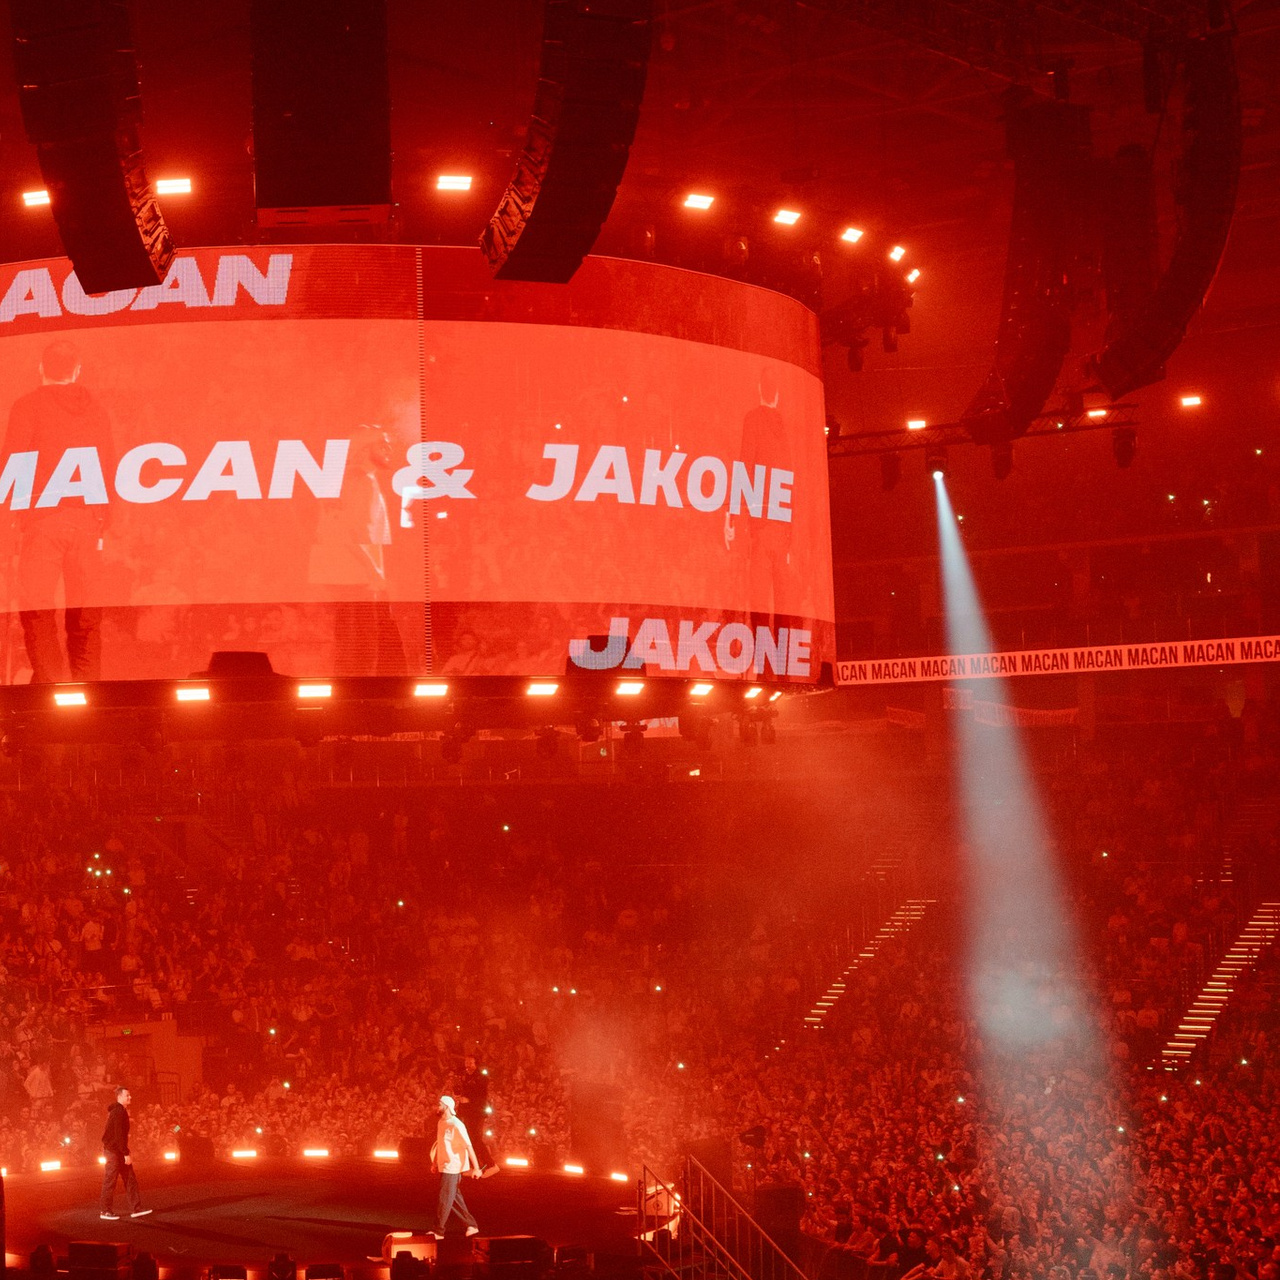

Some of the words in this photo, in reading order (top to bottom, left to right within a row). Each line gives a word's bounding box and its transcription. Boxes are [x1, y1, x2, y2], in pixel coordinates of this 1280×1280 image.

[393, 440, 477, 500] &
[526, 443, 795, 523] JAKONE
[569, 616, 813, 677] JAKONE
[872, 660, 917, 680] MACAN
[921, 658, 966, 678] MACAN
[970, 655, 1017, 675] MACAN
[1021, 651, 1069, 672] MACAN
[1074, 649, 1124, 669] MACAN
[1128, 645, 1179, 666] MACAN
[1183, 642, 1236, 663] MACAN
